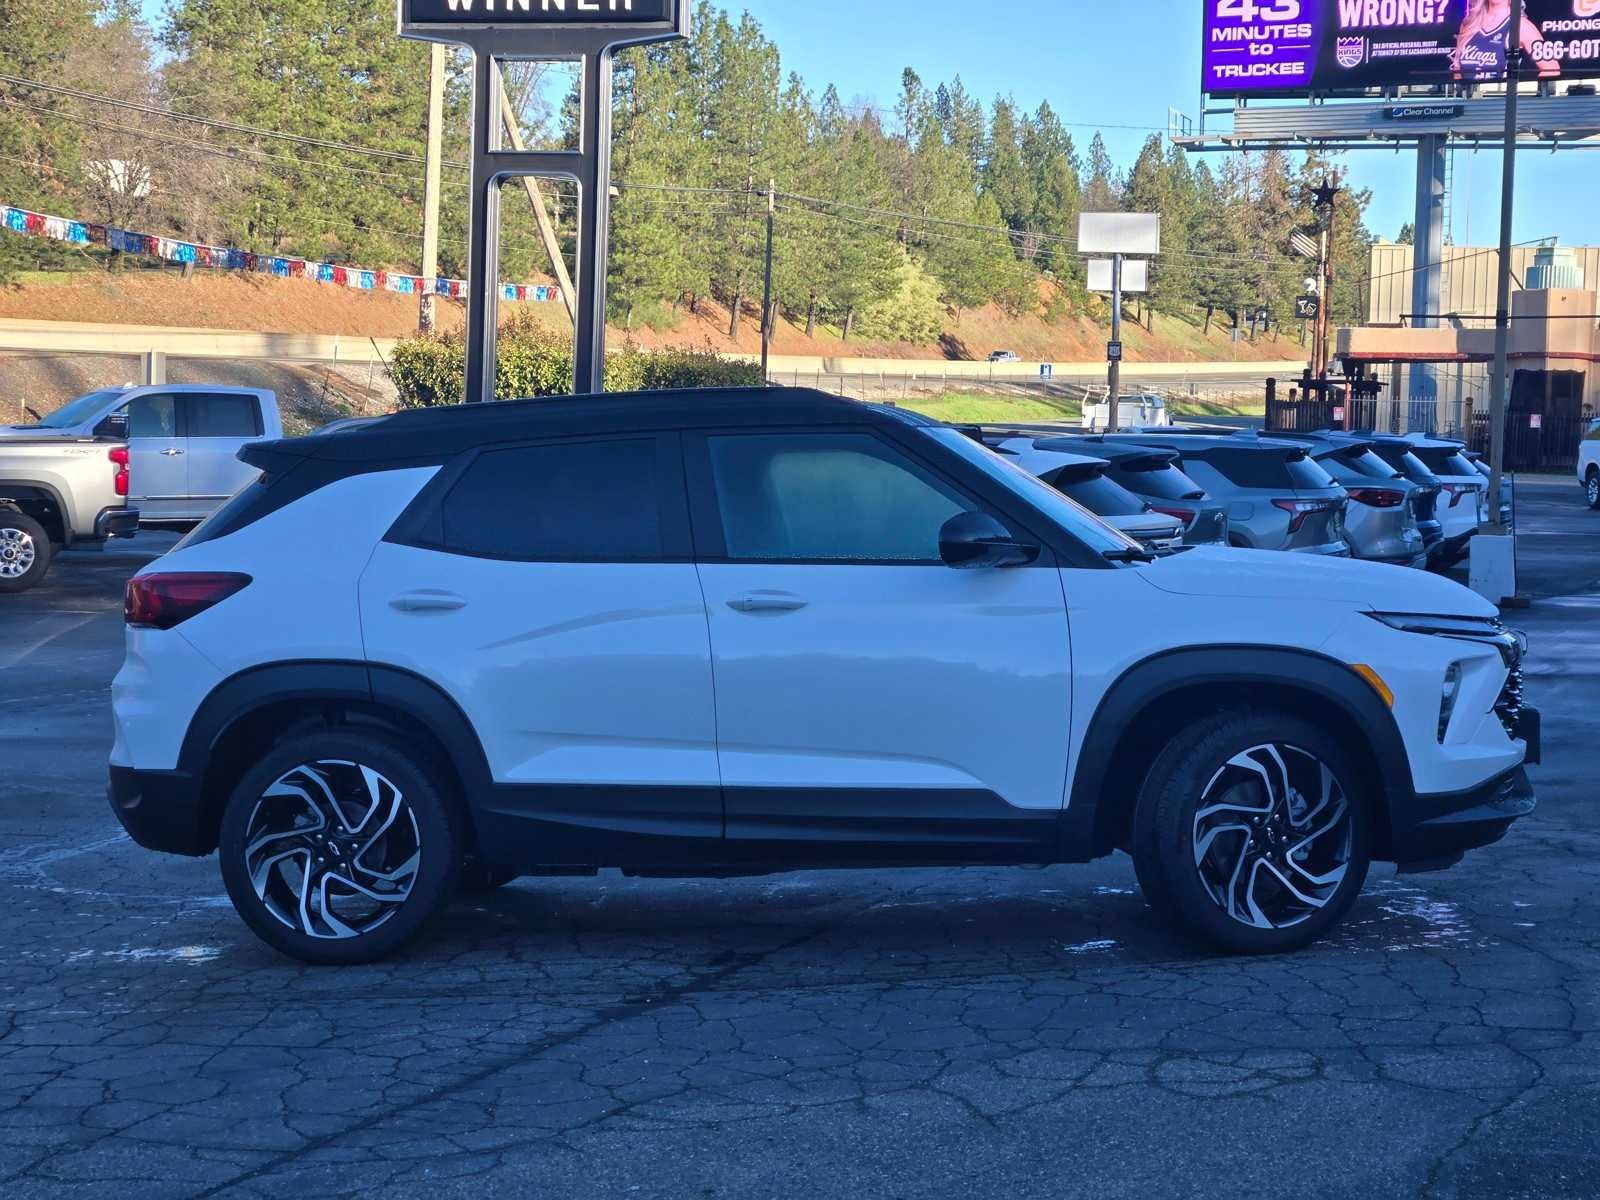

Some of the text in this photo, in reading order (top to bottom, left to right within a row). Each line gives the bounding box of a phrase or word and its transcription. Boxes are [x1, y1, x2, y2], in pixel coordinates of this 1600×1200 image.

[1216, 0, 1300, 22] 43
[1338, 0, 1449, 28] WRONG?
[1211, 23, 1313, 42] MINUTES
[1542, 19, 1600, 32] PHOONG
[1248, 42, 1274, 56] to
[1338, 48, 1362, 56] KINGS
[1460, 45, 1498, 66] Kings
[1532, 39, 1600, 60] 866-GOT
[1213, 61, 1305, 78] TRUCKEE
[1404, 107, 1454, 116] Clear Channel
